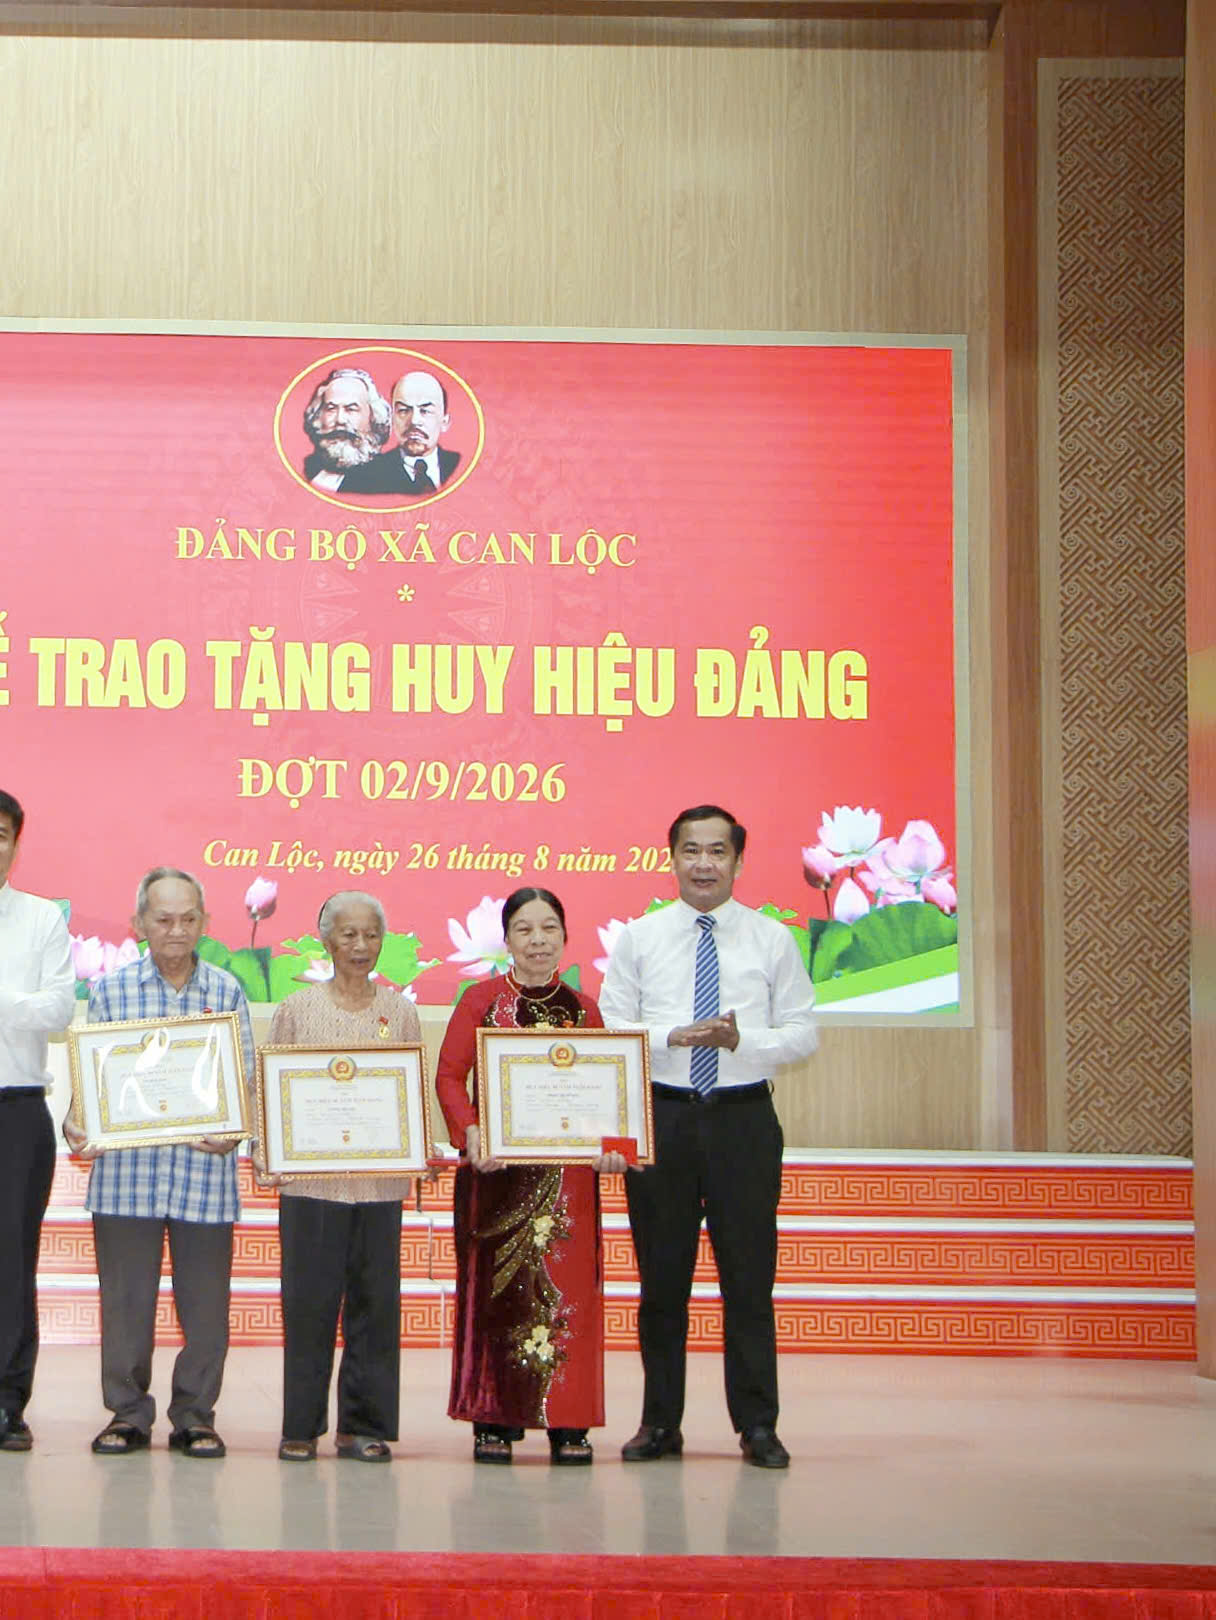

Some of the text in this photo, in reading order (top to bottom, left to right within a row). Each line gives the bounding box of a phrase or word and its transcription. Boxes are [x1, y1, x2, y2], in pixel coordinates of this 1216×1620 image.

[176, 519, 637, 575] ĐẢNG BỘ XÃ CAN LỘC
[28, 636, 188, 709] TRAO
[205, 625, 373, 727] TẶNG
[391, 642, 515, 715] HUY
[533, 631, 676, 733] HIỆU
[693, 625, 869, 721] ĐẢNG
[238, 756, 567, 809] ĐỢT 02/9/2026
[203, 839, 673, 878] Can Lộc, ngày 26 tháng 8 năm 202
